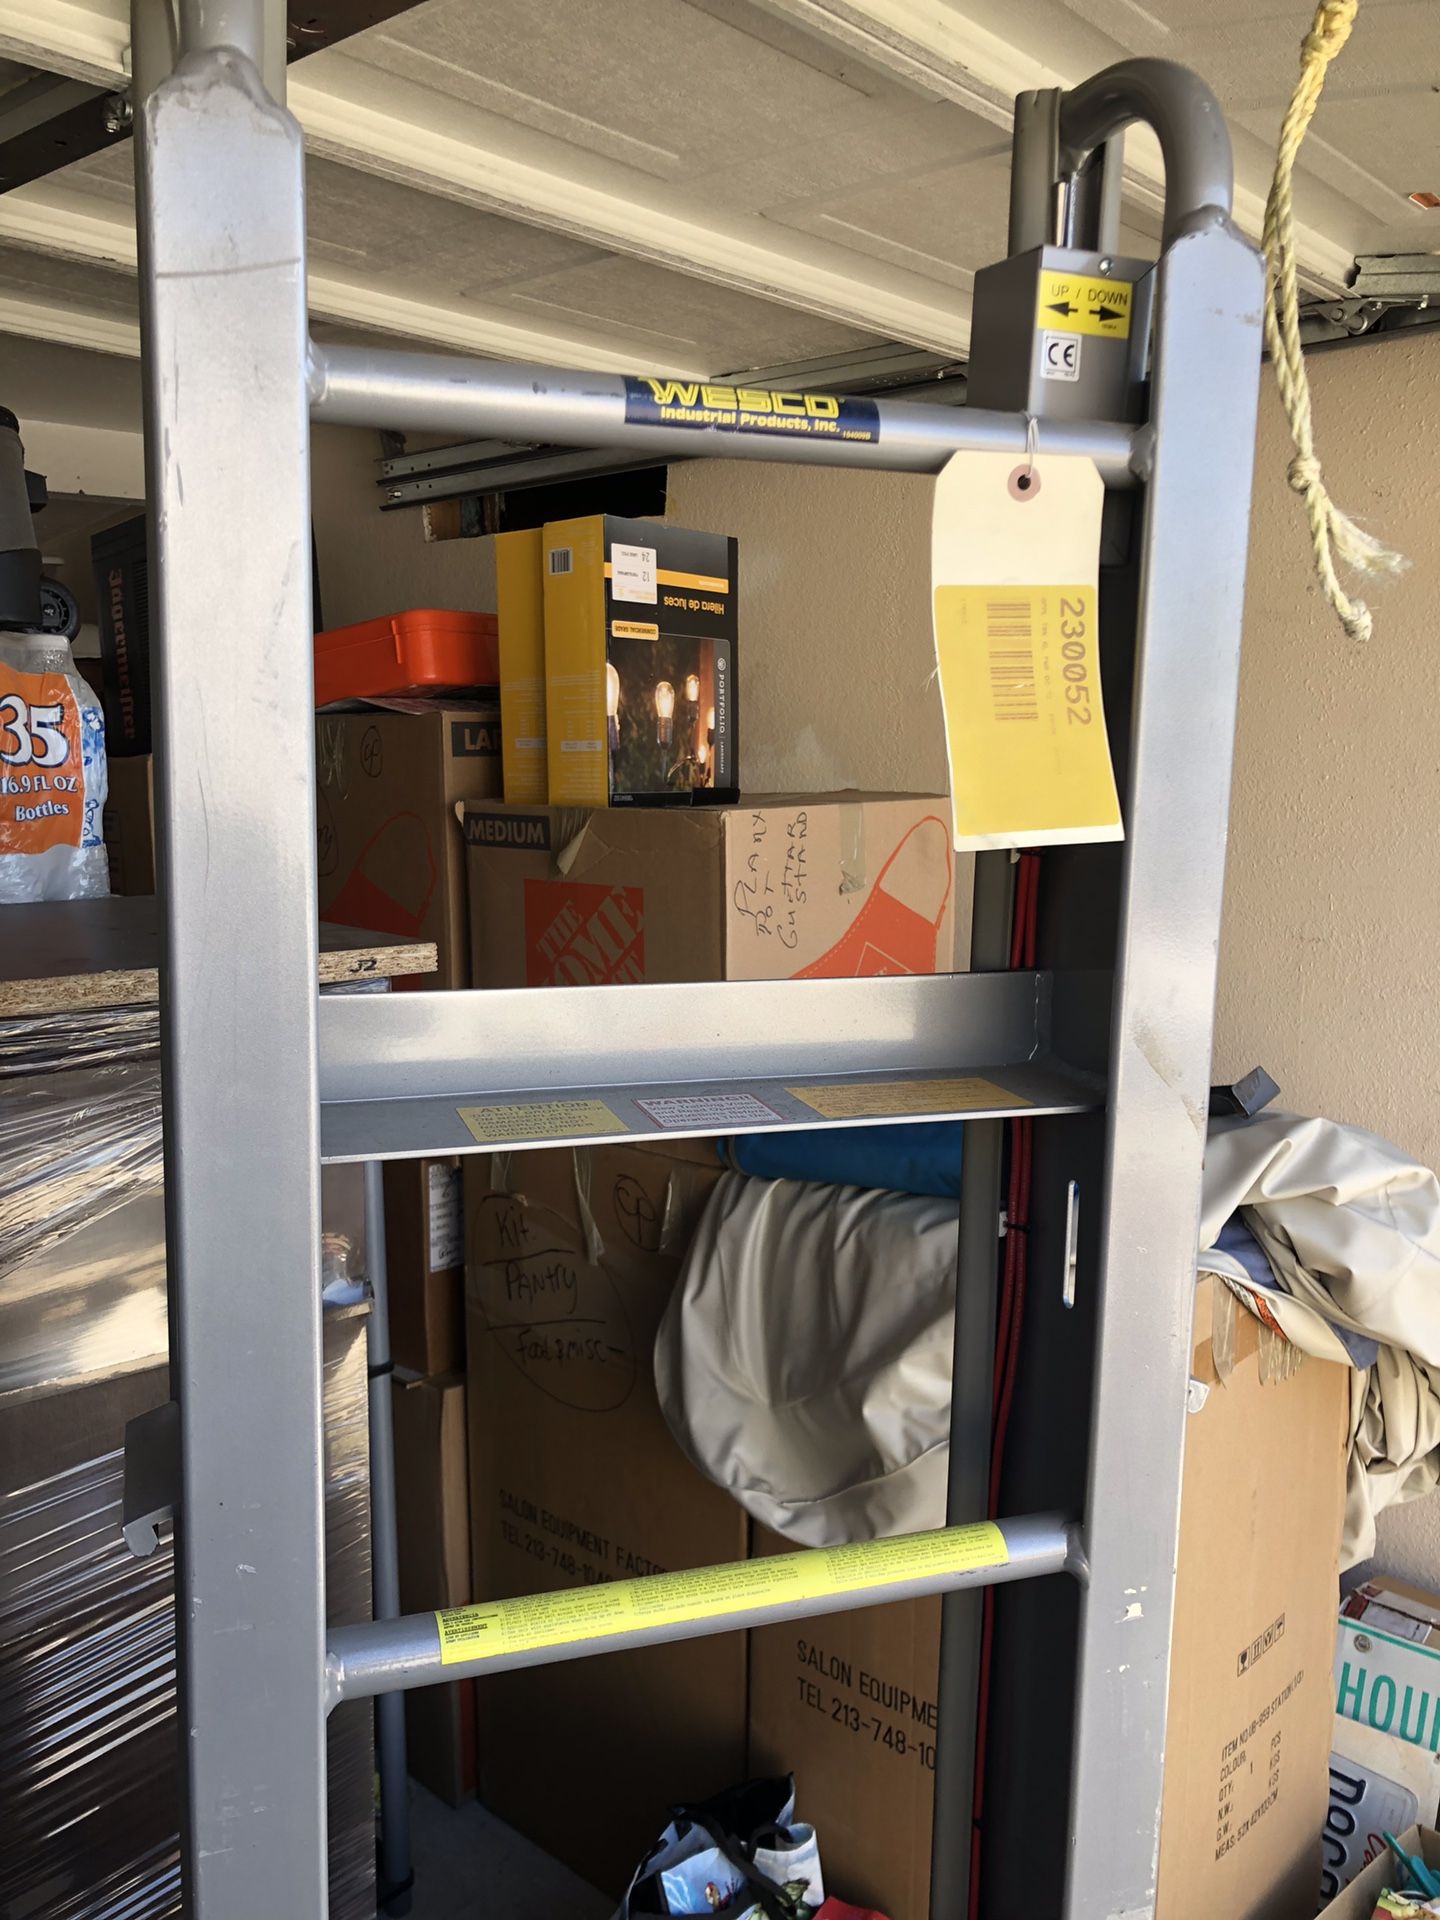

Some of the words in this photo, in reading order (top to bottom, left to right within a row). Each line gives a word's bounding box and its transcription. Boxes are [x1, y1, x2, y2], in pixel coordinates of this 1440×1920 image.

[1051, 284, 1069, 297] UP
[1087, 288, 1128, 306] DOWN
[1047, 342, 1075, 368] CE
[638, 377, 840, 419] WESCO
[660, 406, 736, 425] Industrial
[740, 412, 812, 431] Products,
[814, 420, 841, 433] Inc.
[663, 595, 687, 611] luces
[1059, 596, 1093, 727] 230052
[718, 673, 726, 734] PORTFOLIO
[34, 774, 52, 793] FL
[53, 773, 78, 792] OZ
[15, 800, 70, 822] Bottles
[470, 819, 545, 845] MEDIUM
[536, 899, 584, 962] THE
[480, 1102, 589, 1113] ATTENTION
[541, 1509, 610, 1560] EQUIPMENT
[797, 1640, 852, 1688] SALON
[797, 1676, 826, 1714] TEL
